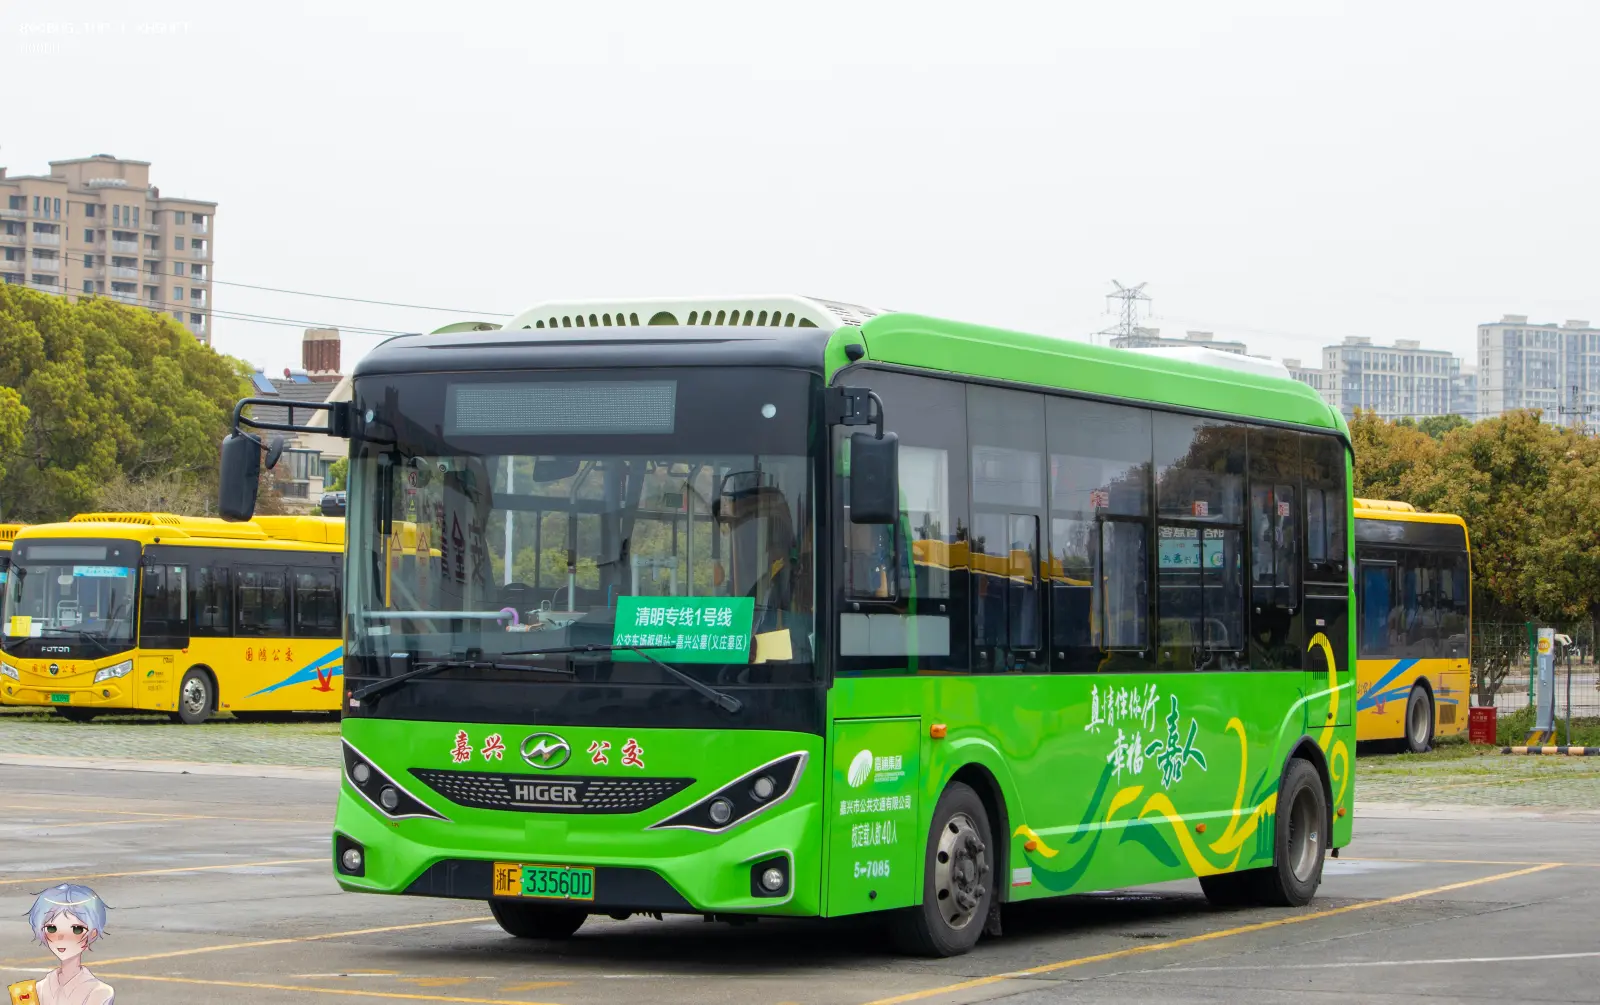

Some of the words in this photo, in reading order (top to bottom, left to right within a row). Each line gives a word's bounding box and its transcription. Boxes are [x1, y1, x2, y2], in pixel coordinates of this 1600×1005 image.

[635, 607, 732, 627] 清明专线1号线
[450, 730, 505, 763] 嘉兴
[587, 738, 645, 769] 公交
[514, 784, 578, 804] HIGER
[839, 795, 912, 816] 嘉兴市公共交通有限公司
[853, 859, 890, 878] 5-7085
[526, 869, 592, 896] 33560D
